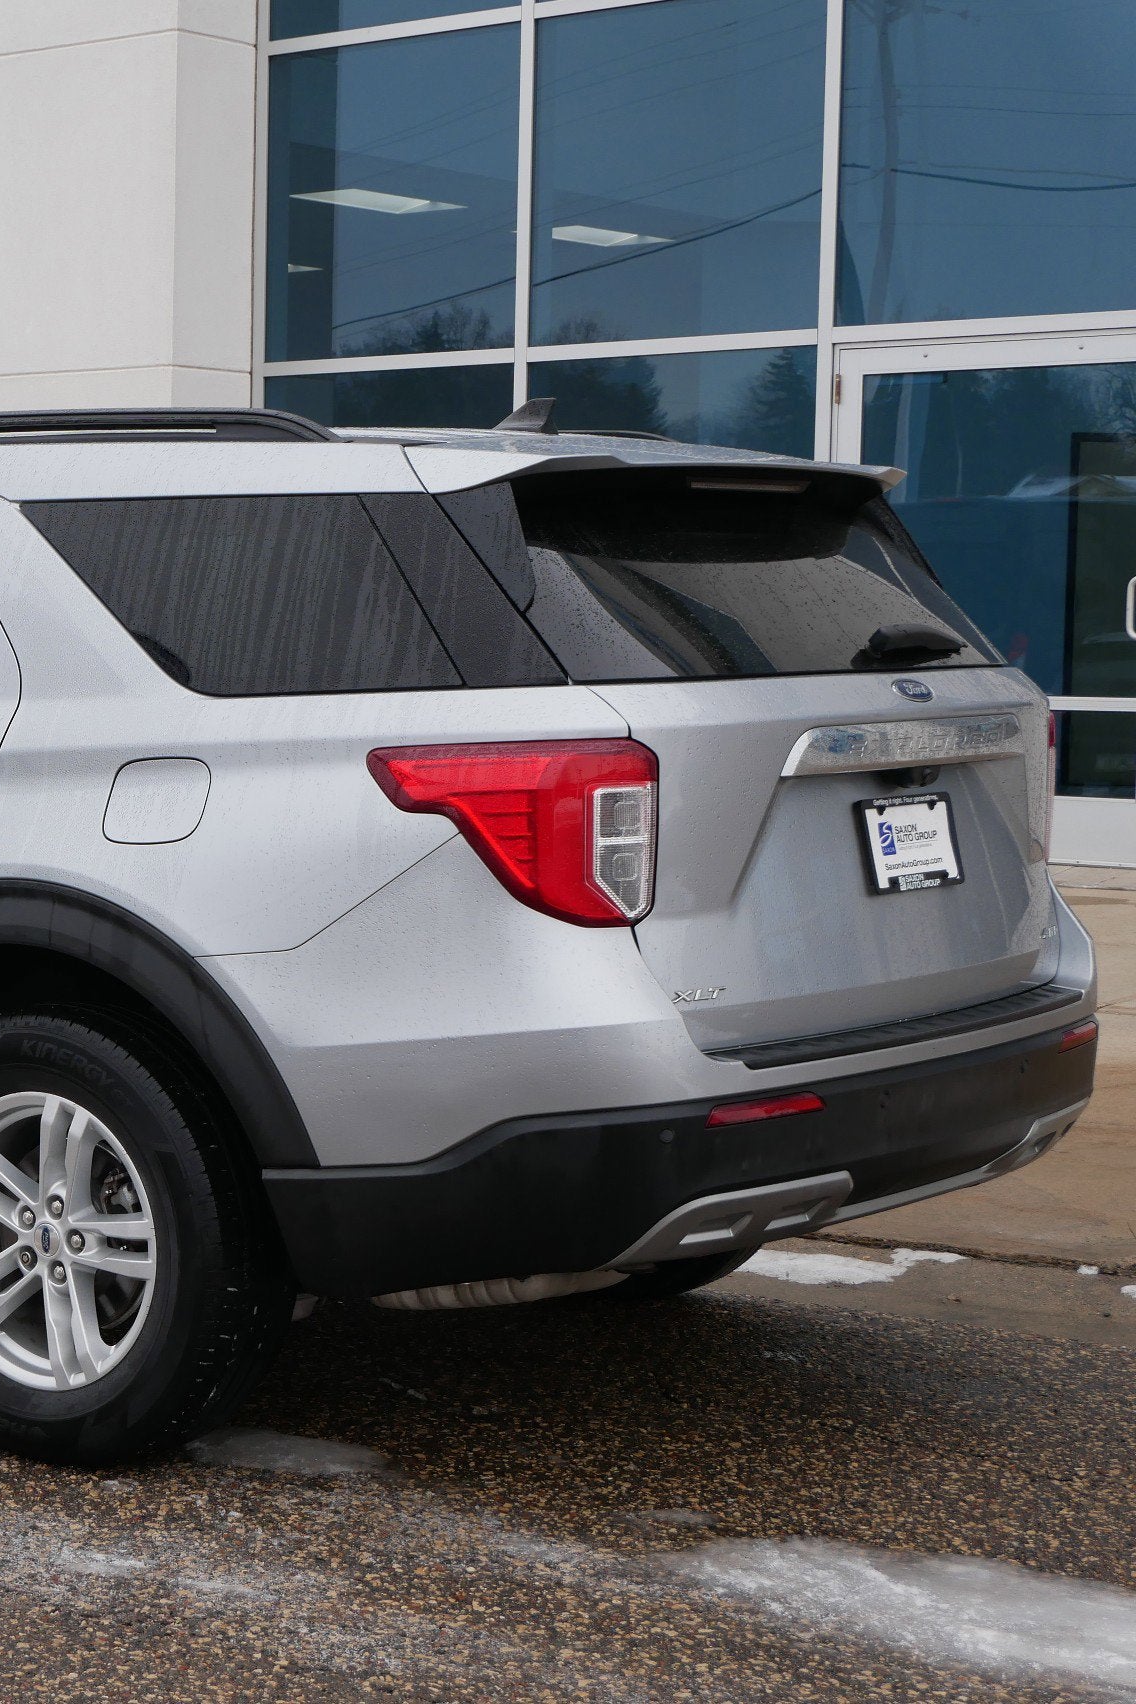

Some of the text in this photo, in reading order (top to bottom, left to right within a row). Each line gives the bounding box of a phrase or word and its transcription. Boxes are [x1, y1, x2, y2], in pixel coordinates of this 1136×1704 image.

[894, 824, 917, 835] SAXON
[896, 830, 937, 843] AUTO GROUP
[671, 986, 727, 1004] XLT
